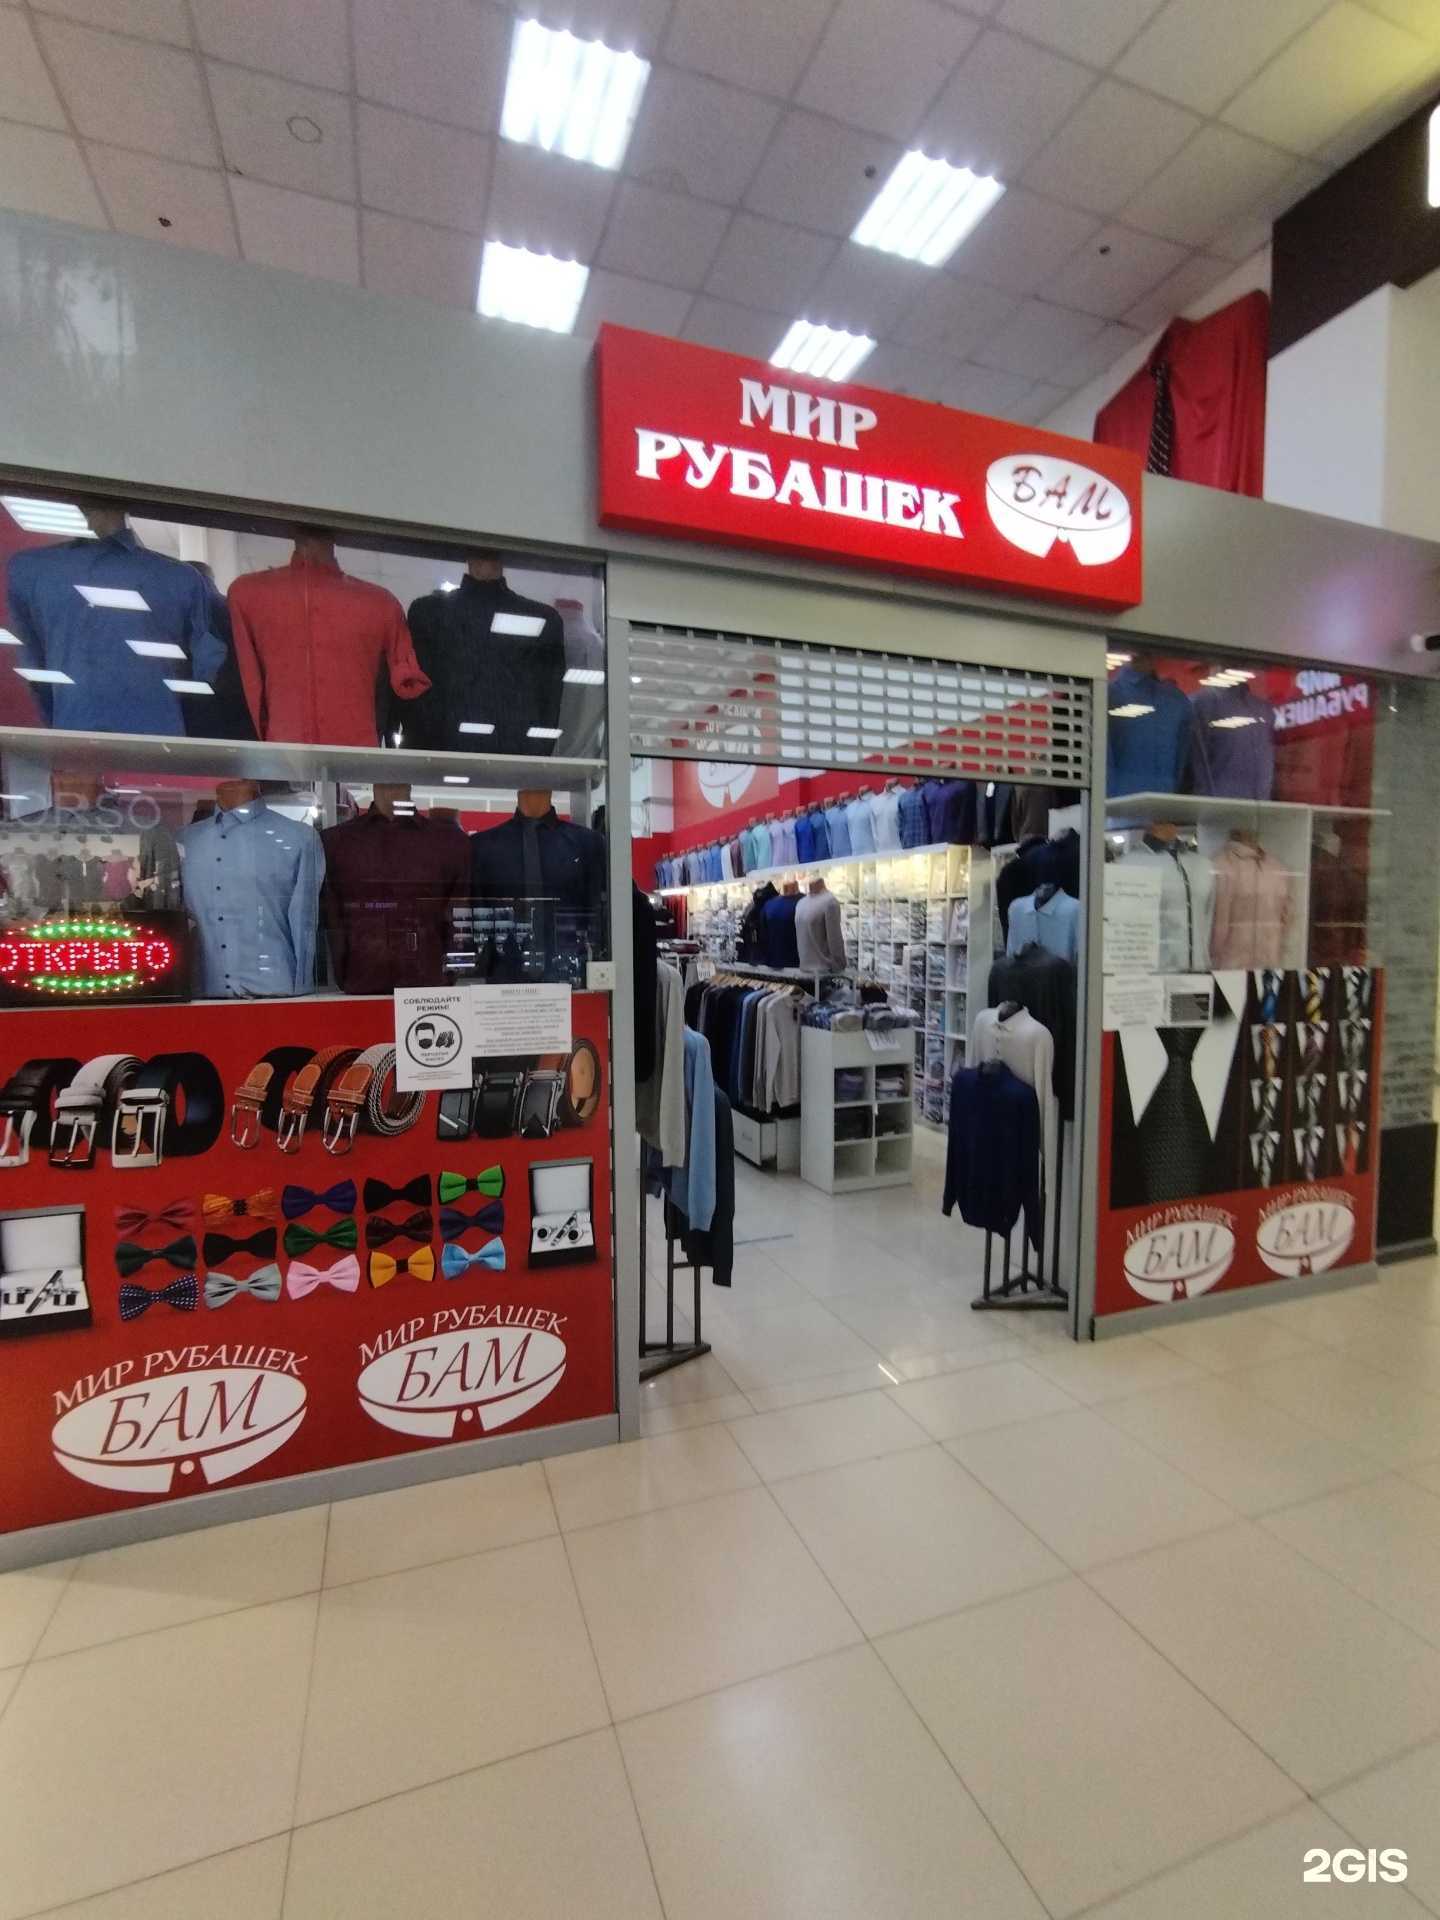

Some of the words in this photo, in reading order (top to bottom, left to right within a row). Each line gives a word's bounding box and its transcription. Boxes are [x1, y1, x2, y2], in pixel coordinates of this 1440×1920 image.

[738, 377, 878, 450] МИР
[635, 427, 964, 539] РУБАШЕК
[0, 942, 170, 972] ОТКРЫТО
[358, 1317, 425, 1365] МИР
[432, 1304, 568, 1335] РУБАШЕК
[396, 1332, 533, 1403] БАМ
[52, 1360, 134, 1415] МИР
[143, 1344, 308, 1376] РУБАШЕК
[100, 1374, 265, 1456] БАМ
